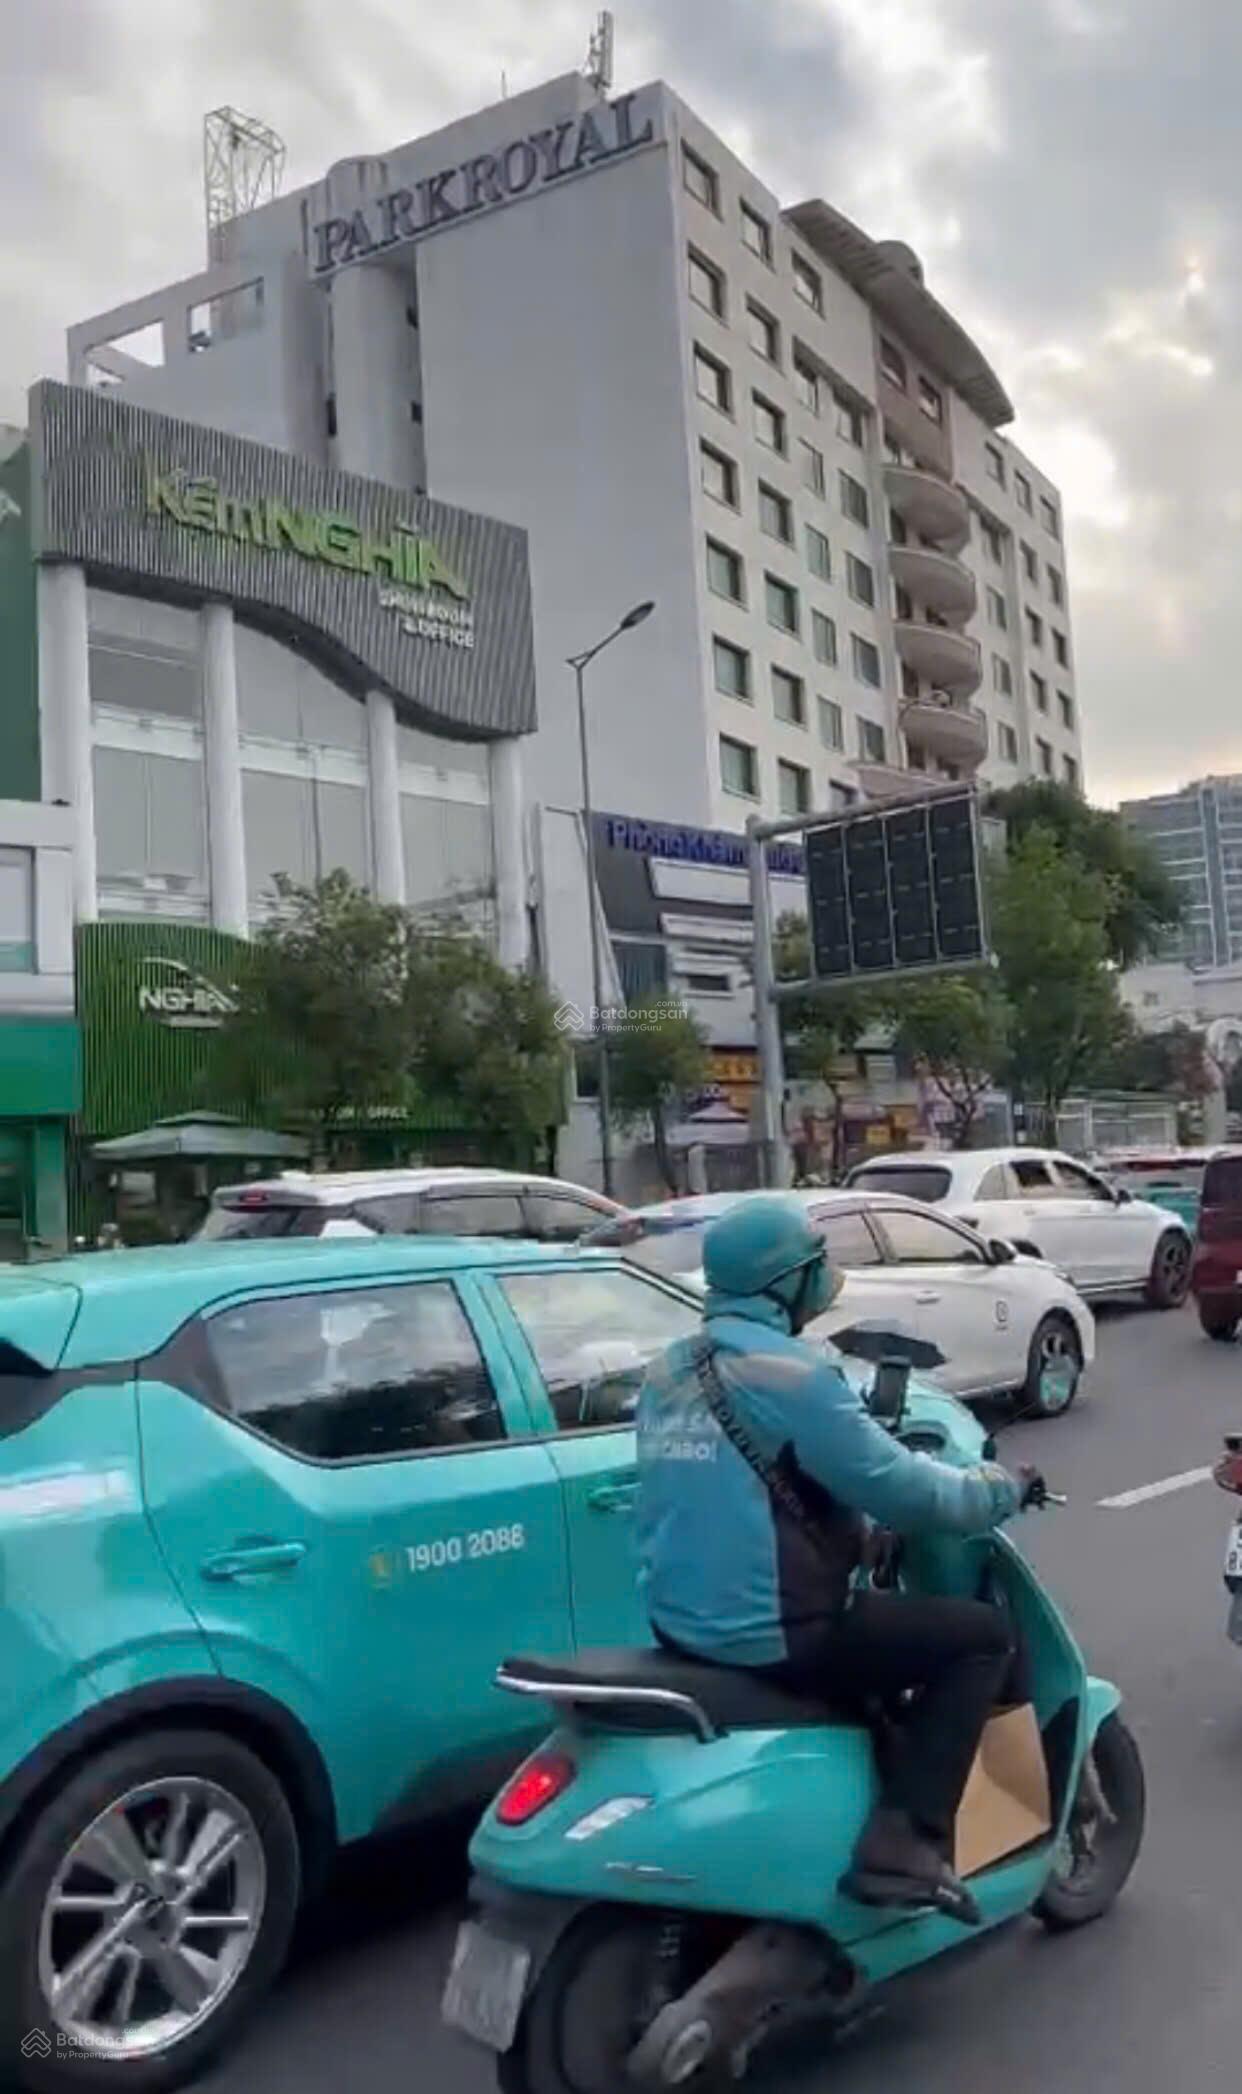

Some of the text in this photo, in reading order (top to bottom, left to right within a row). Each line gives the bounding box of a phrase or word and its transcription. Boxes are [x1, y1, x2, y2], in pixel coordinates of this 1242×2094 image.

[314, 94, 654, 272] PARKROYAL
[405, 1523, 525, 1572] 1900 2088
